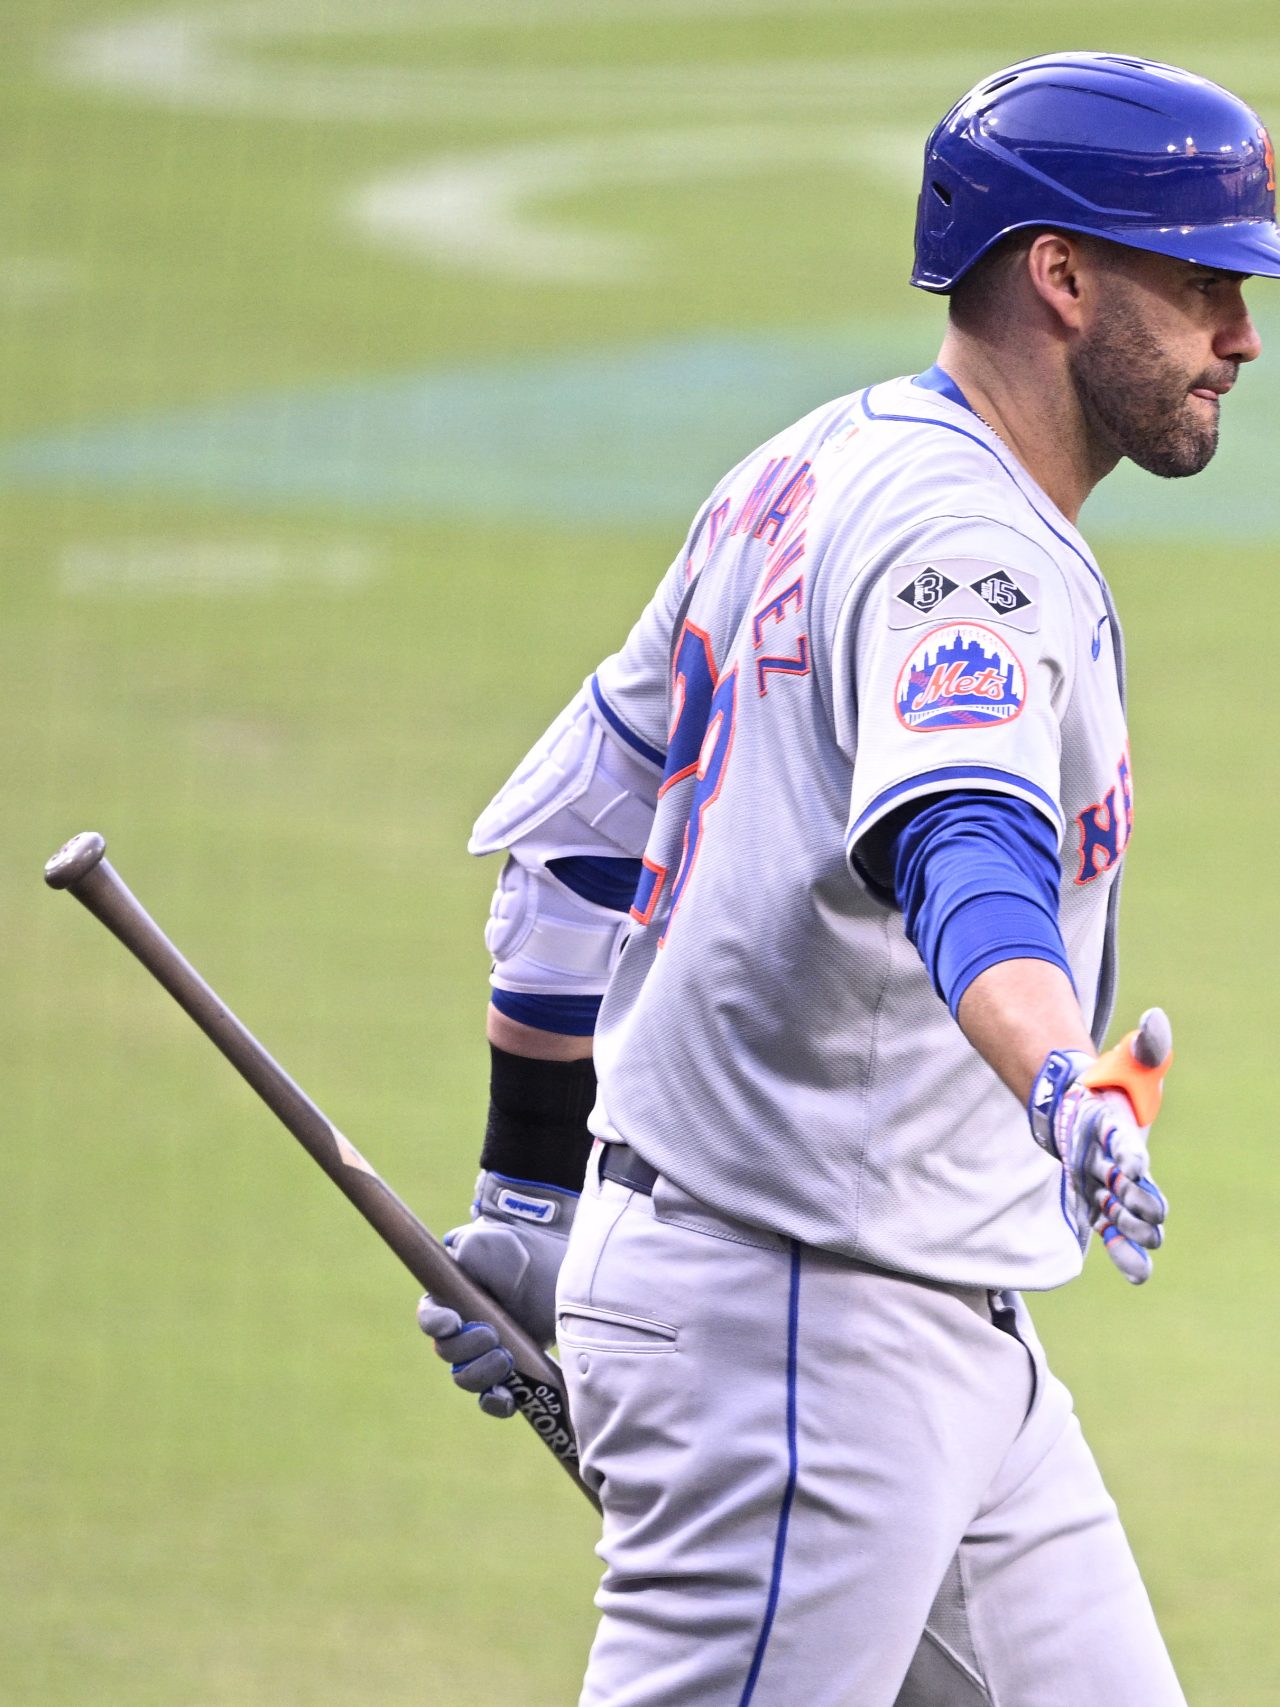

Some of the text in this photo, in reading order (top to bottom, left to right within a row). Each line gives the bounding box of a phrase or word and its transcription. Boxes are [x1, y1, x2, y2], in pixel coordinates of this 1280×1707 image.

[914, 572, 943, 609] 3
[902, 661, 1007, 711] Mets
[507, 1370, 578, 1459] ICKORY
[535, 1385, 561, 1414] OLD
